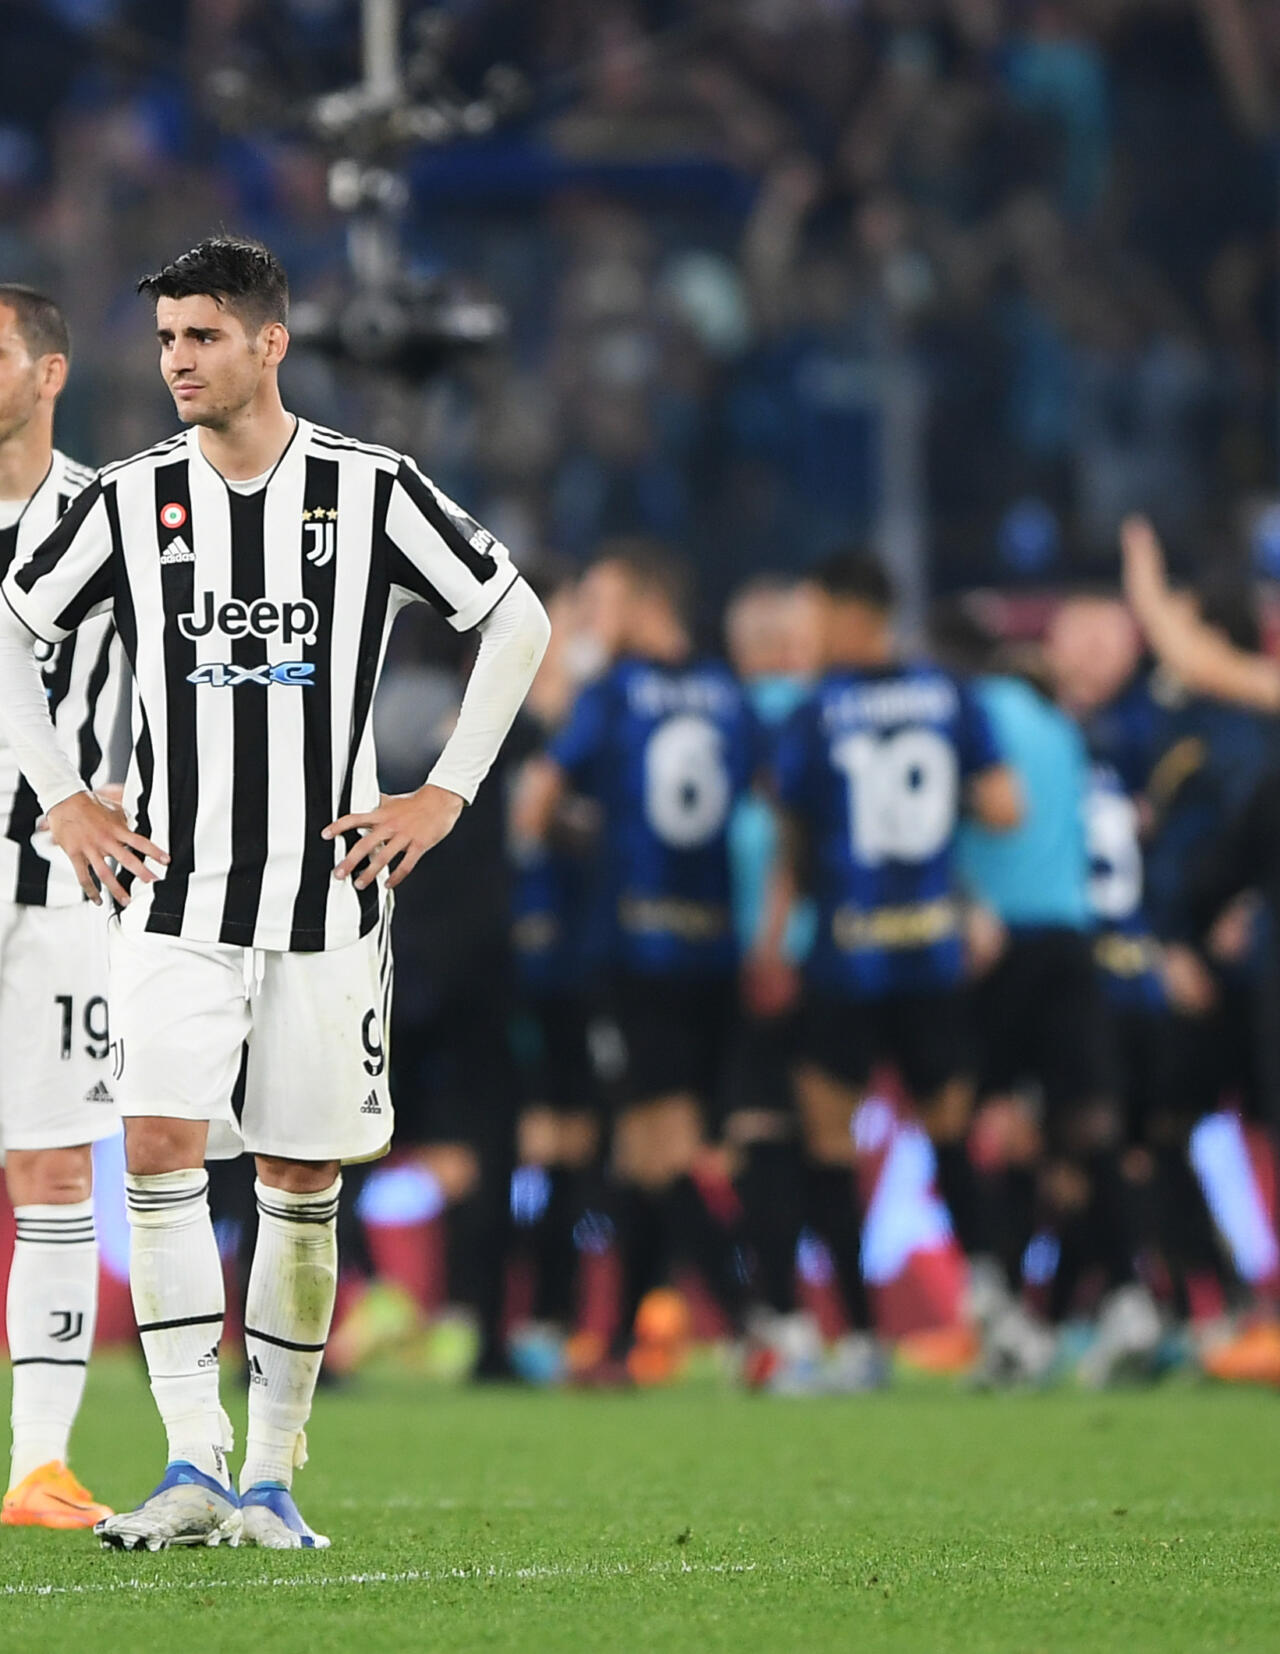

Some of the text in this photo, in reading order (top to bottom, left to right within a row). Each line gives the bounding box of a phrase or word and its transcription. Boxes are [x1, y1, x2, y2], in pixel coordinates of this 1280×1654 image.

[160, 552, 196, 565] adidas
[177, 589, 319, 646] Jeep
[644, 713, 729, 847] 6
[54, 995, 110, 1060] 19
[361, 1007, 385, 1077] 9
